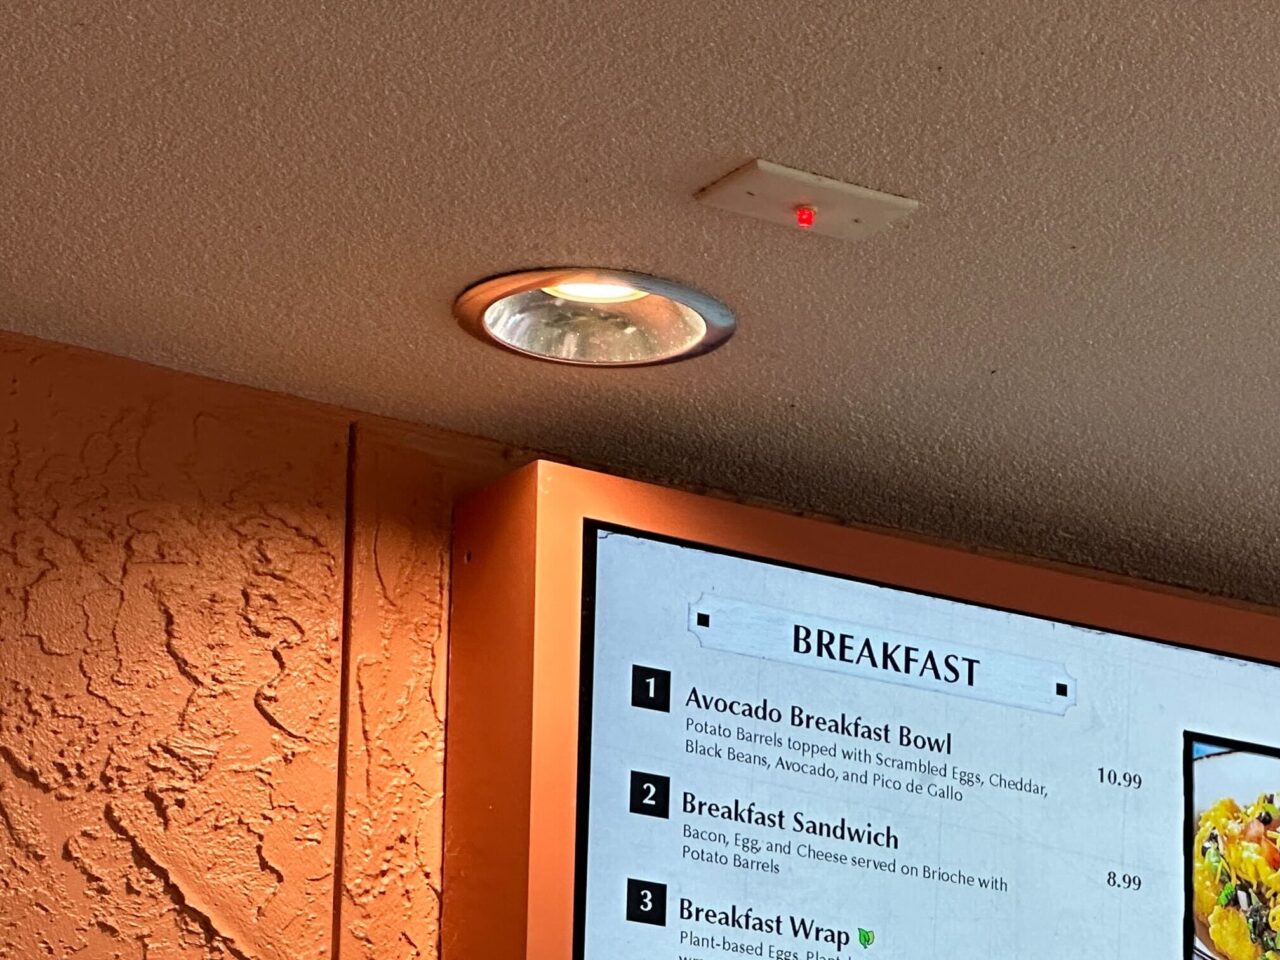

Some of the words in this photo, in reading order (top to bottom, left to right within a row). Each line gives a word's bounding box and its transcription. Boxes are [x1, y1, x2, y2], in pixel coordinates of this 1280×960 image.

[793, 624, 981, 687] BREAKFAST
[645, 677, 655, 698] 1
[685, 686, 782, 723] Avocado
[790, 705, 891, 744] Breakfast
[899, 725, 951, 755] Bowl
[686, 717, 732, 739] Potato
[736, 726, 783, 748] Barrels
[787, 736, 837, 759] topped
[841, 747, 872, 764] with
[875, 752, 947, 778] Scrambled
[952, 766, 985, 788] Eggs,
[989, 773, 1048, 798] Cheddar,
[642, 782, 656, 805] 2
[1098, 767, 1142, 790] 10.99
[682, 791, 785, 830] Breakfast
[792, 811, 898, 850] Sandwich
[682, 844, 729, 866] Potato
[733, 853, 780, 874] Barrels
[683, 823, 729, 848] Bacon,
[734, 832, 762, 855] Egg,
[766, 840, 791, 855] and
[796, 843, 848, 865] Cheese
[851, 856, 896, 873] served
[900, 864, 918, 877] on
[922, 865, 975, 887] Brioche
[977, 876, 1008, 892] with
[1106, 871, 1142, 891] 8.99
[640, 889, 653, 912] 3
[679, 897, 783, 936] Breakfast
[789, 915, 850, 952] Wrap
[680, 930, 763, 957] Plant-based
